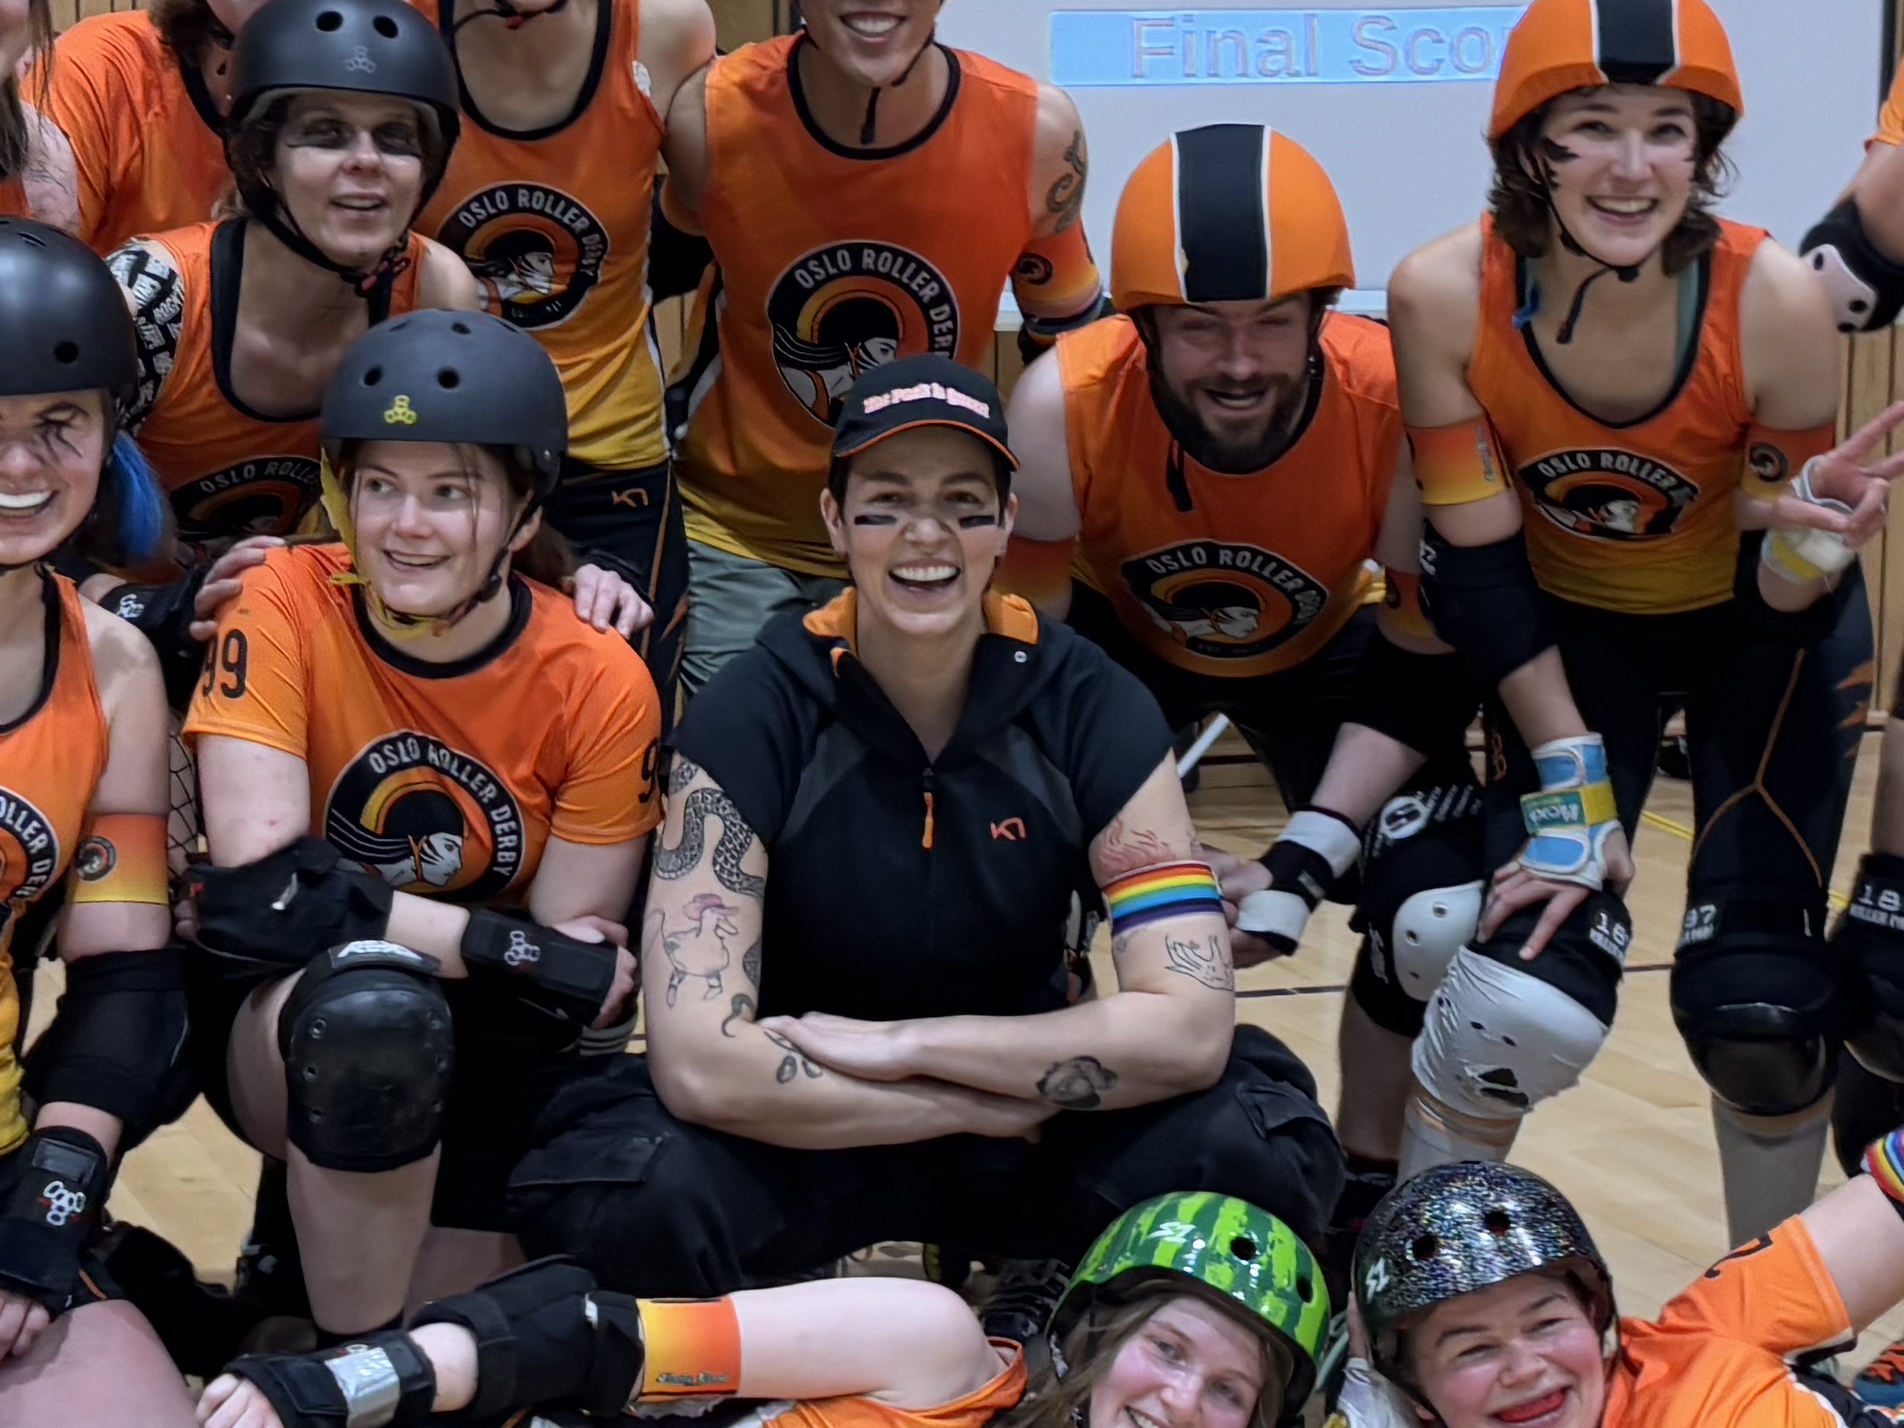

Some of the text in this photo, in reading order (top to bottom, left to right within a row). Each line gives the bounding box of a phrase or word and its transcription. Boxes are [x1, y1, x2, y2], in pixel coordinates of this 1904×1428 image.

[1131, 12, 1504, 80] Final Sco
[459, 190, 509, 229] OSLO
[517, 187, 591, 233] ROLLER
[795, 247, 955, 360] OSLO ROLLER DER
[199, 463, 256, 493] OSLO
[1537, 452, 1678, 488] OSLO ROLLER
[1146, 546, 1306, 593] OSLO ROLLER
[368, 737, 421, 774] OSLO
[489, 803, 517, 877] DERBY
